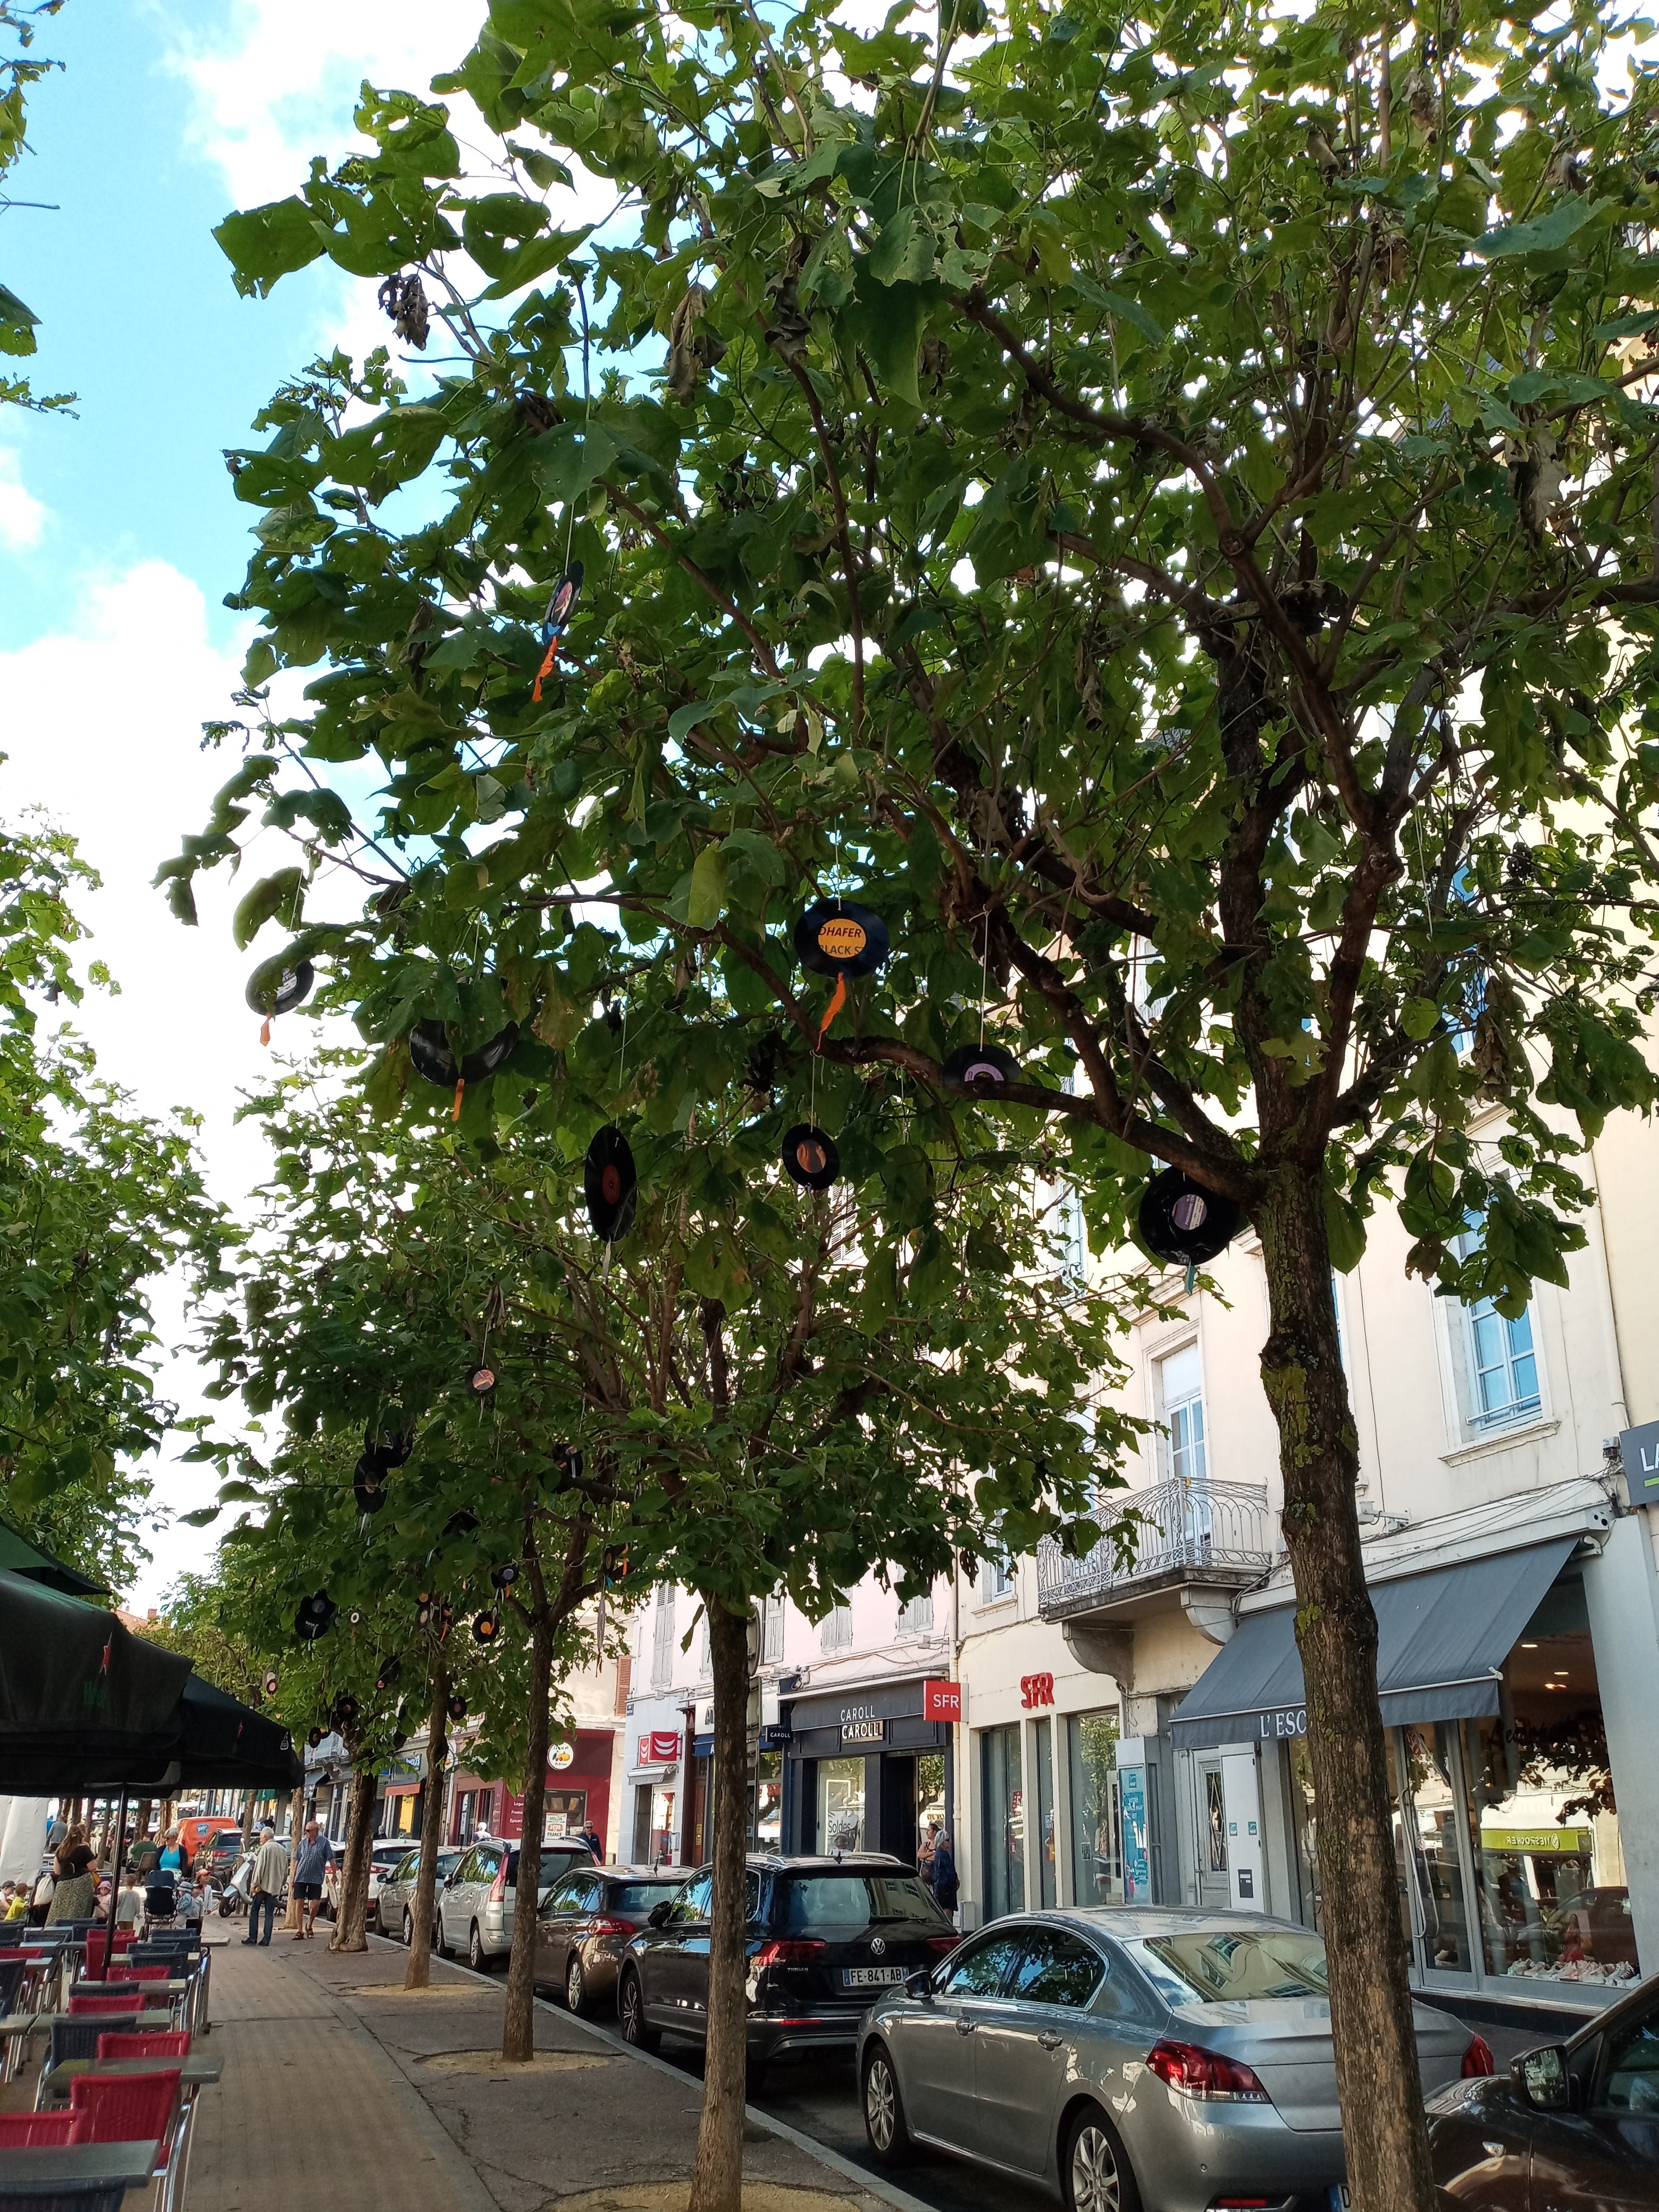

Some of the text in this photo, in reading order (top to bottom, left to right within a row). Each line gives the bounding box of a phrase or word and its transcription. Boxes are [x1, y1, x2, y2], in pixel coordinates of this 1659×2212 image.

[819, 926, 862, 938] DHAFER
[854, 946, 864, 955] S
[1020, 1672, 1054, 1708] SFR
[933, 1694, 959, 1708] SFR
[841, 1705, 875, 1722] CAROLL
[842, 1721, 878, 1739] CAROLL
[828, 1820, 851, 1833] Soldes
[851, 1968, 902, 1983] FE-841-AB
